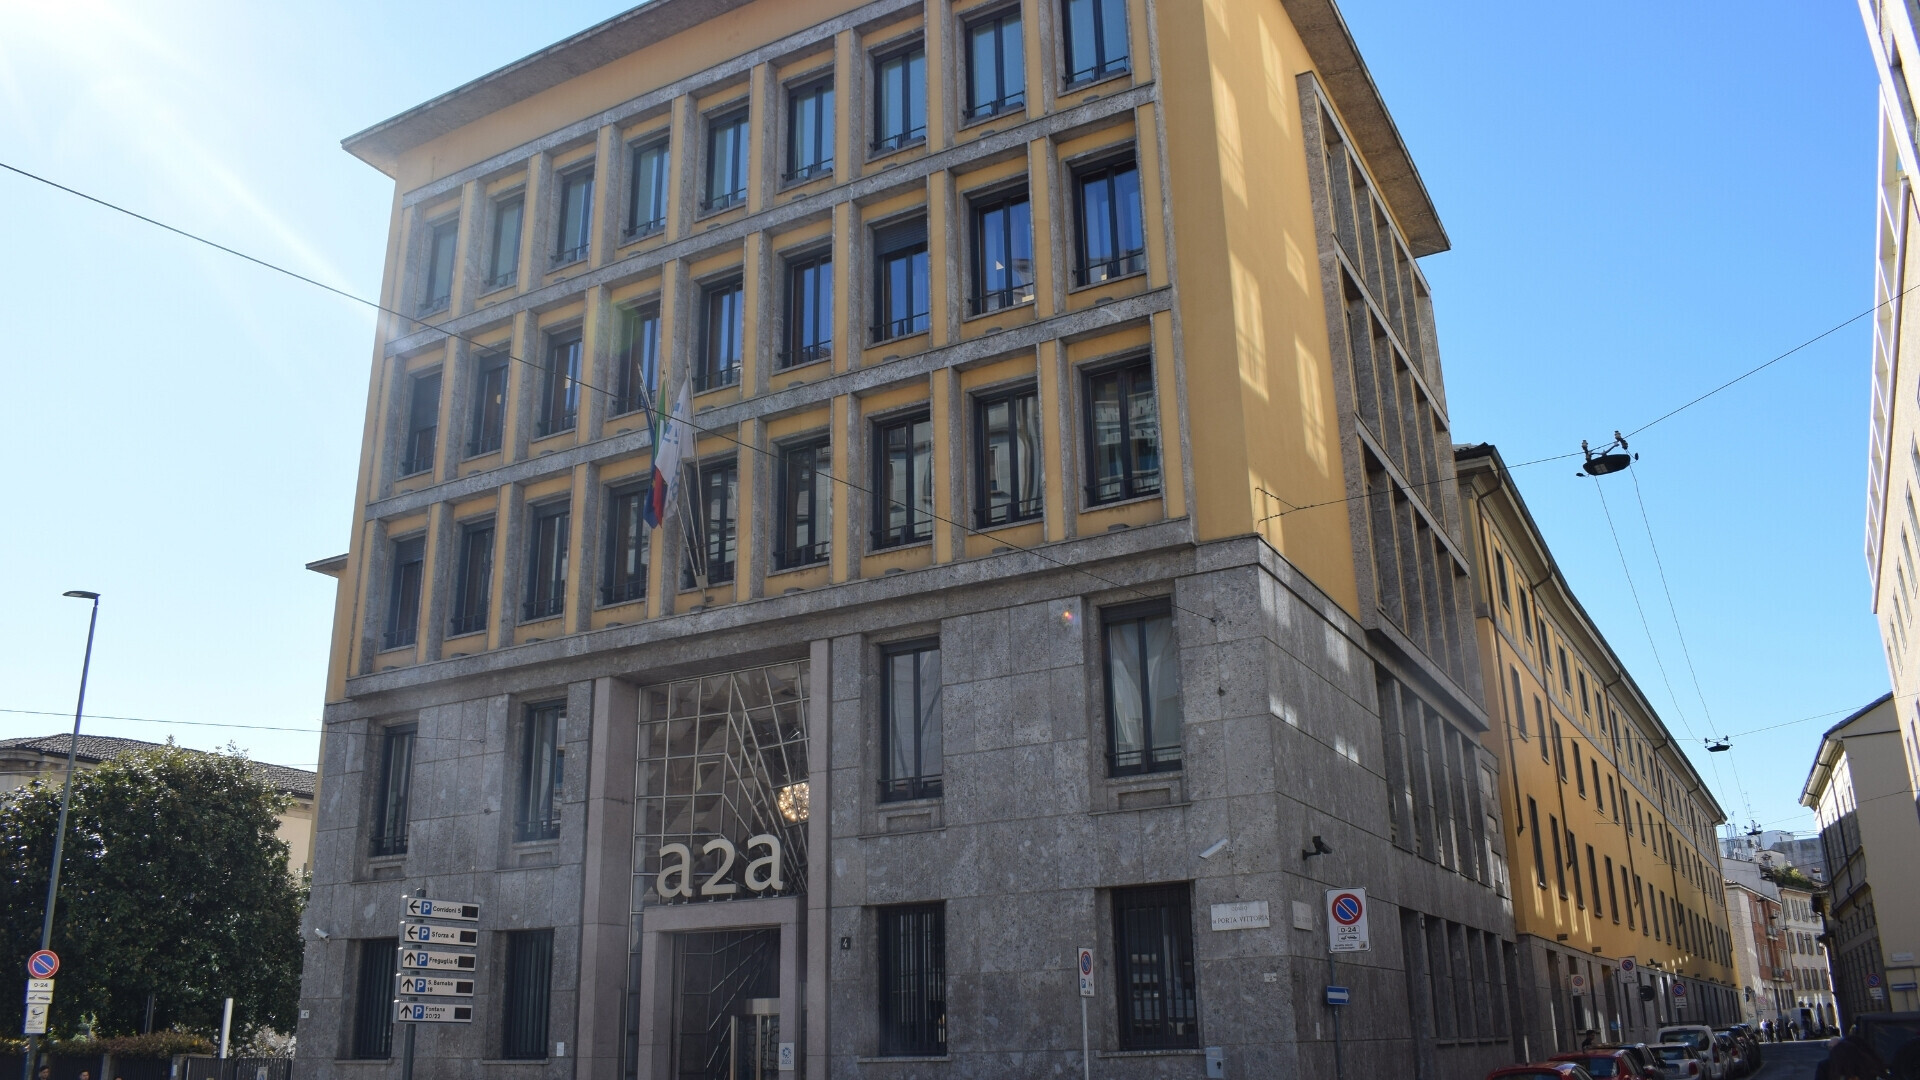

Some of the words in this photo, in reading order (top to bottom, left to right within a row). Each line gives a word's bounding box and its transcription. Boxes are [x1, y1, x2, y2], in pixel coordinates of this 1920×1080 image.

[656, 833, 784, 898] a2a
[432, 905, 456, 914] Corridoni
[1239, 914, 1269, 923] VITTORIA
[429, 957, 453, 965] Freguglia
